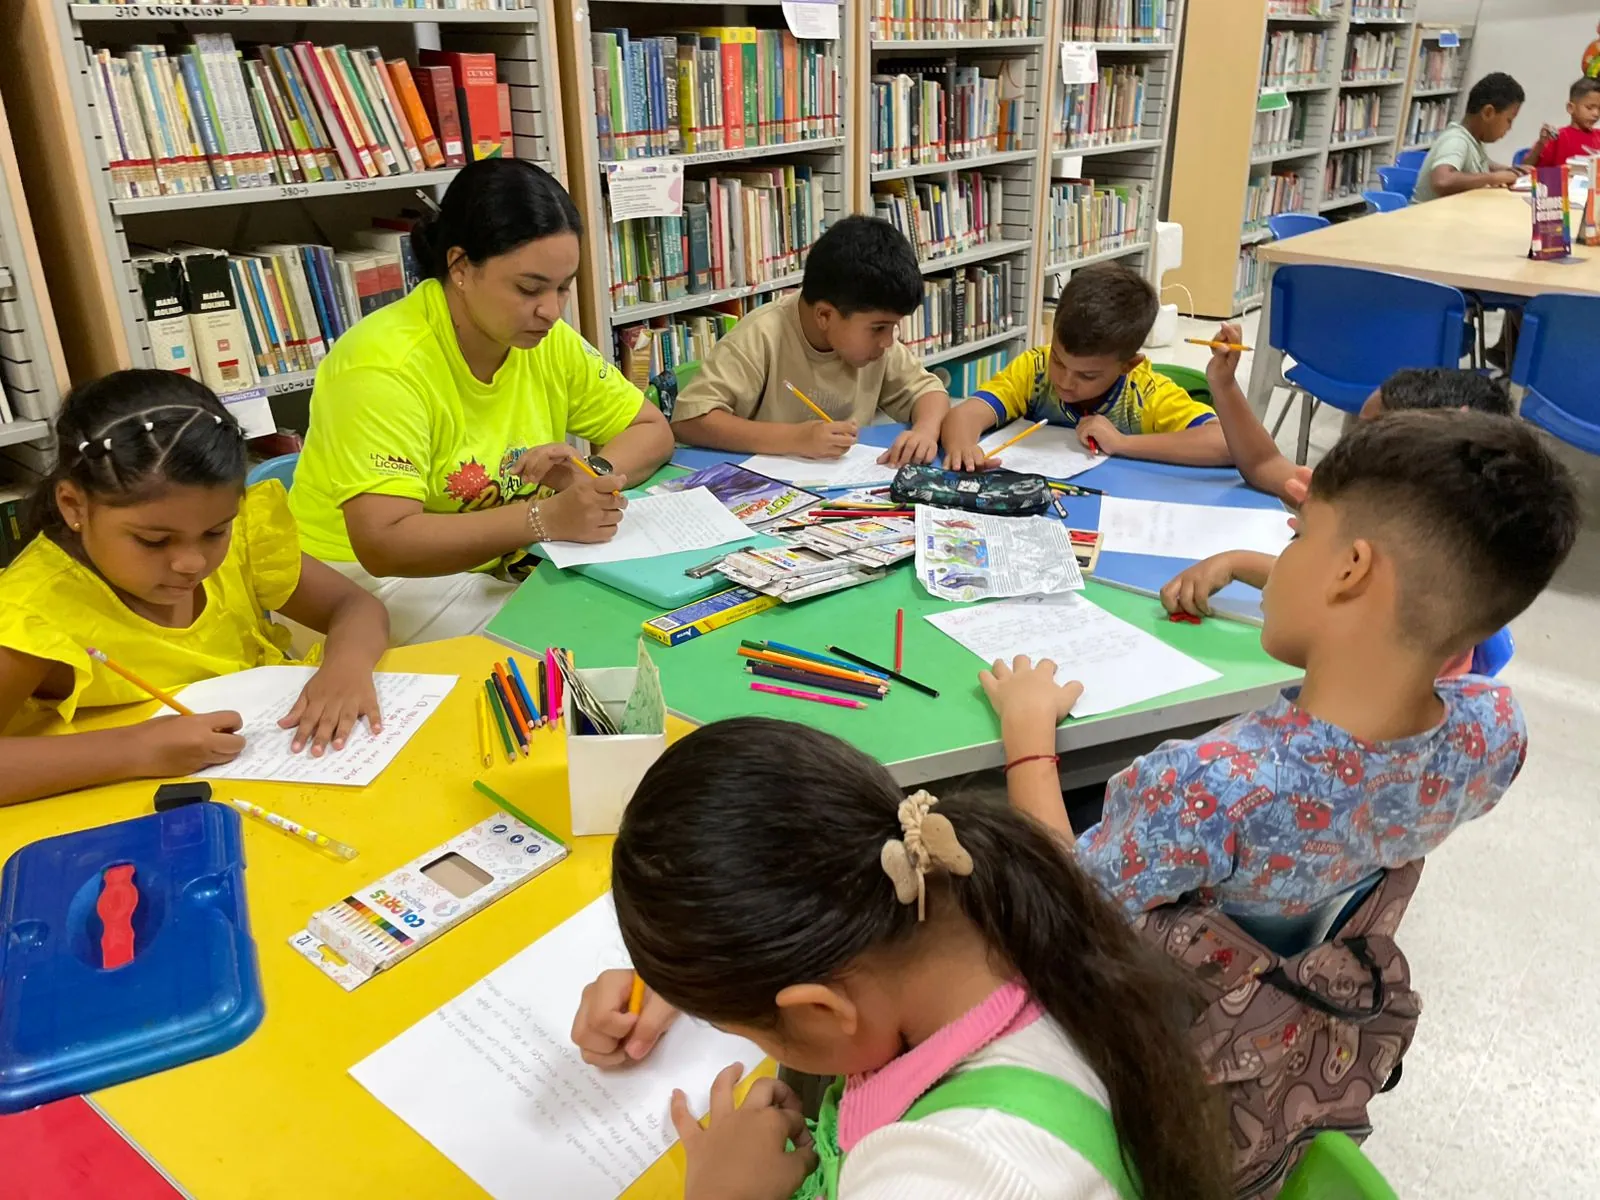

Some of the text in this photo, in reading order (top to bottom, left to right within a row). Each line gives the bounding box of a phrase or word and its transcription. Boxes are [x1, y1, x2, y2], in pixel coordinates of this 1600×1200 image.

[280, 187, 299, 197] 380
[369, 888, 426, 929] COLORES
[294, 933, 312, 946] 12
